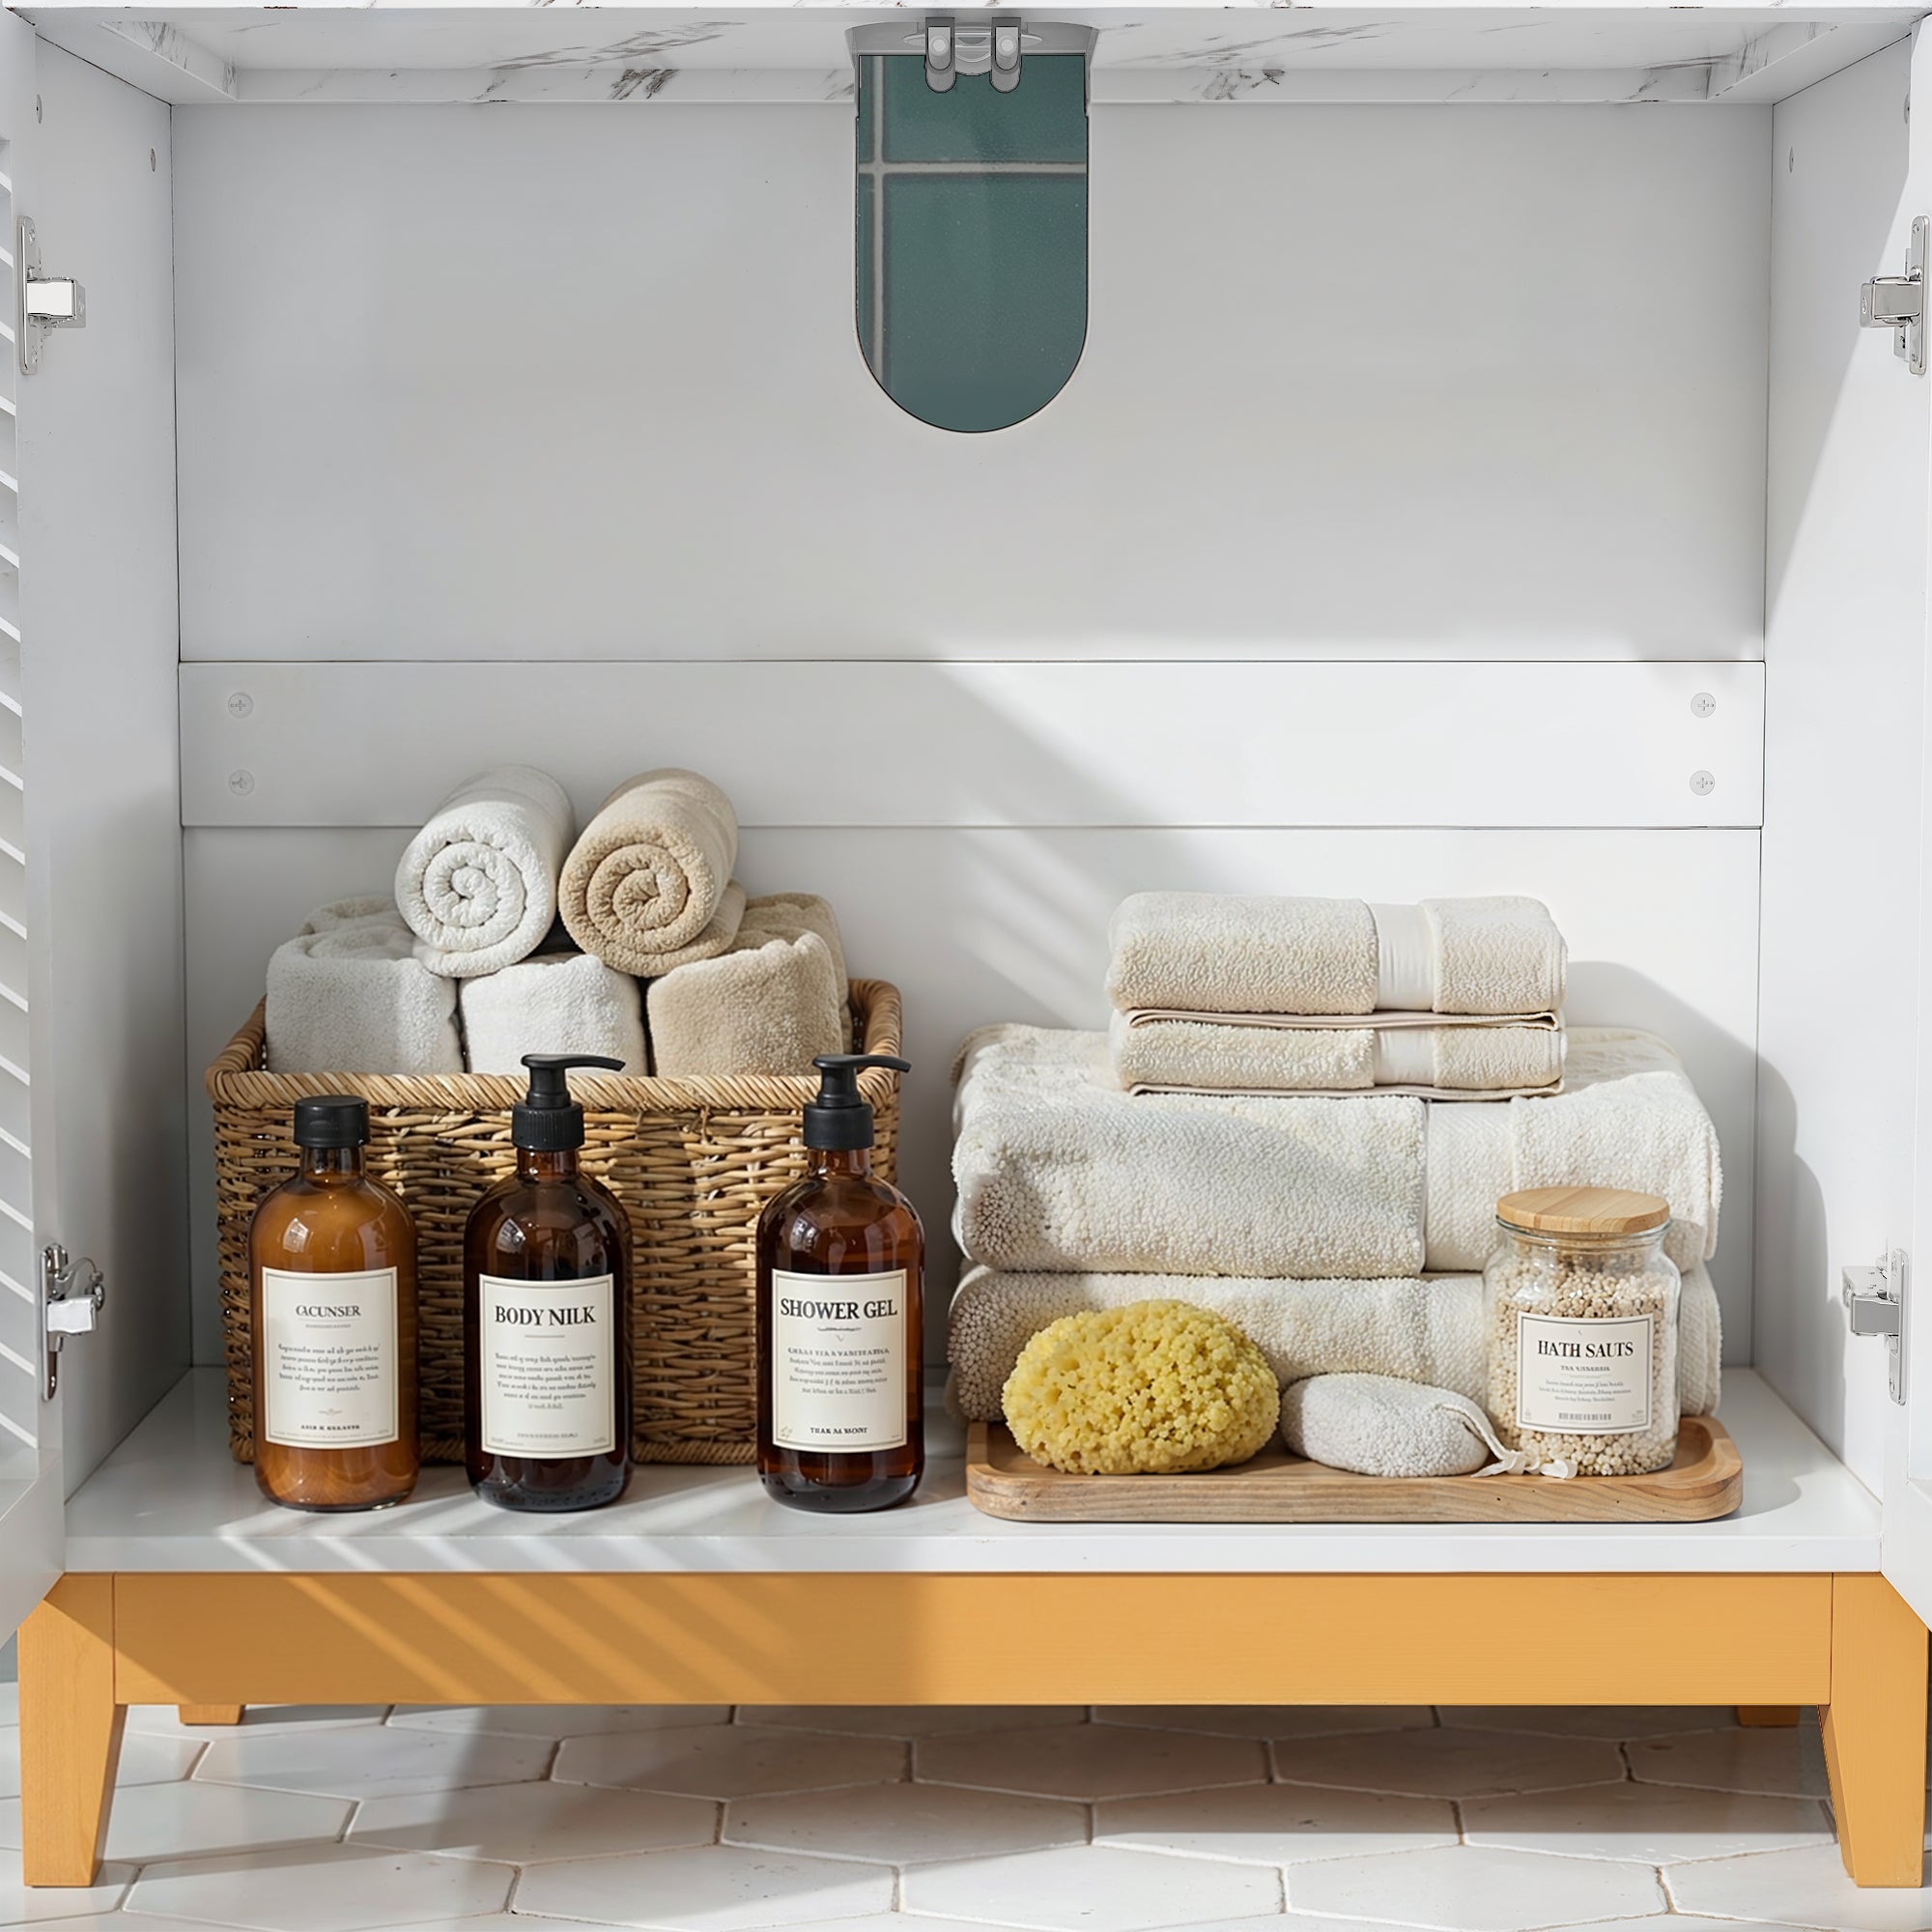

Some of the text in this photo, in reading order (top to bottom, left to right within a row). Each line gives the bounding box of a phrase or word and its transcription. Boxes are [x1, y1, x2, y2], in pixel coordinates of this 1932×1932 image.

[495, 1305, 544, 1326] BODY
[781, 1298, 897, 1320] SHOWER GEL
[1538, 1340, 1634, 1358] HATH SAUTS
